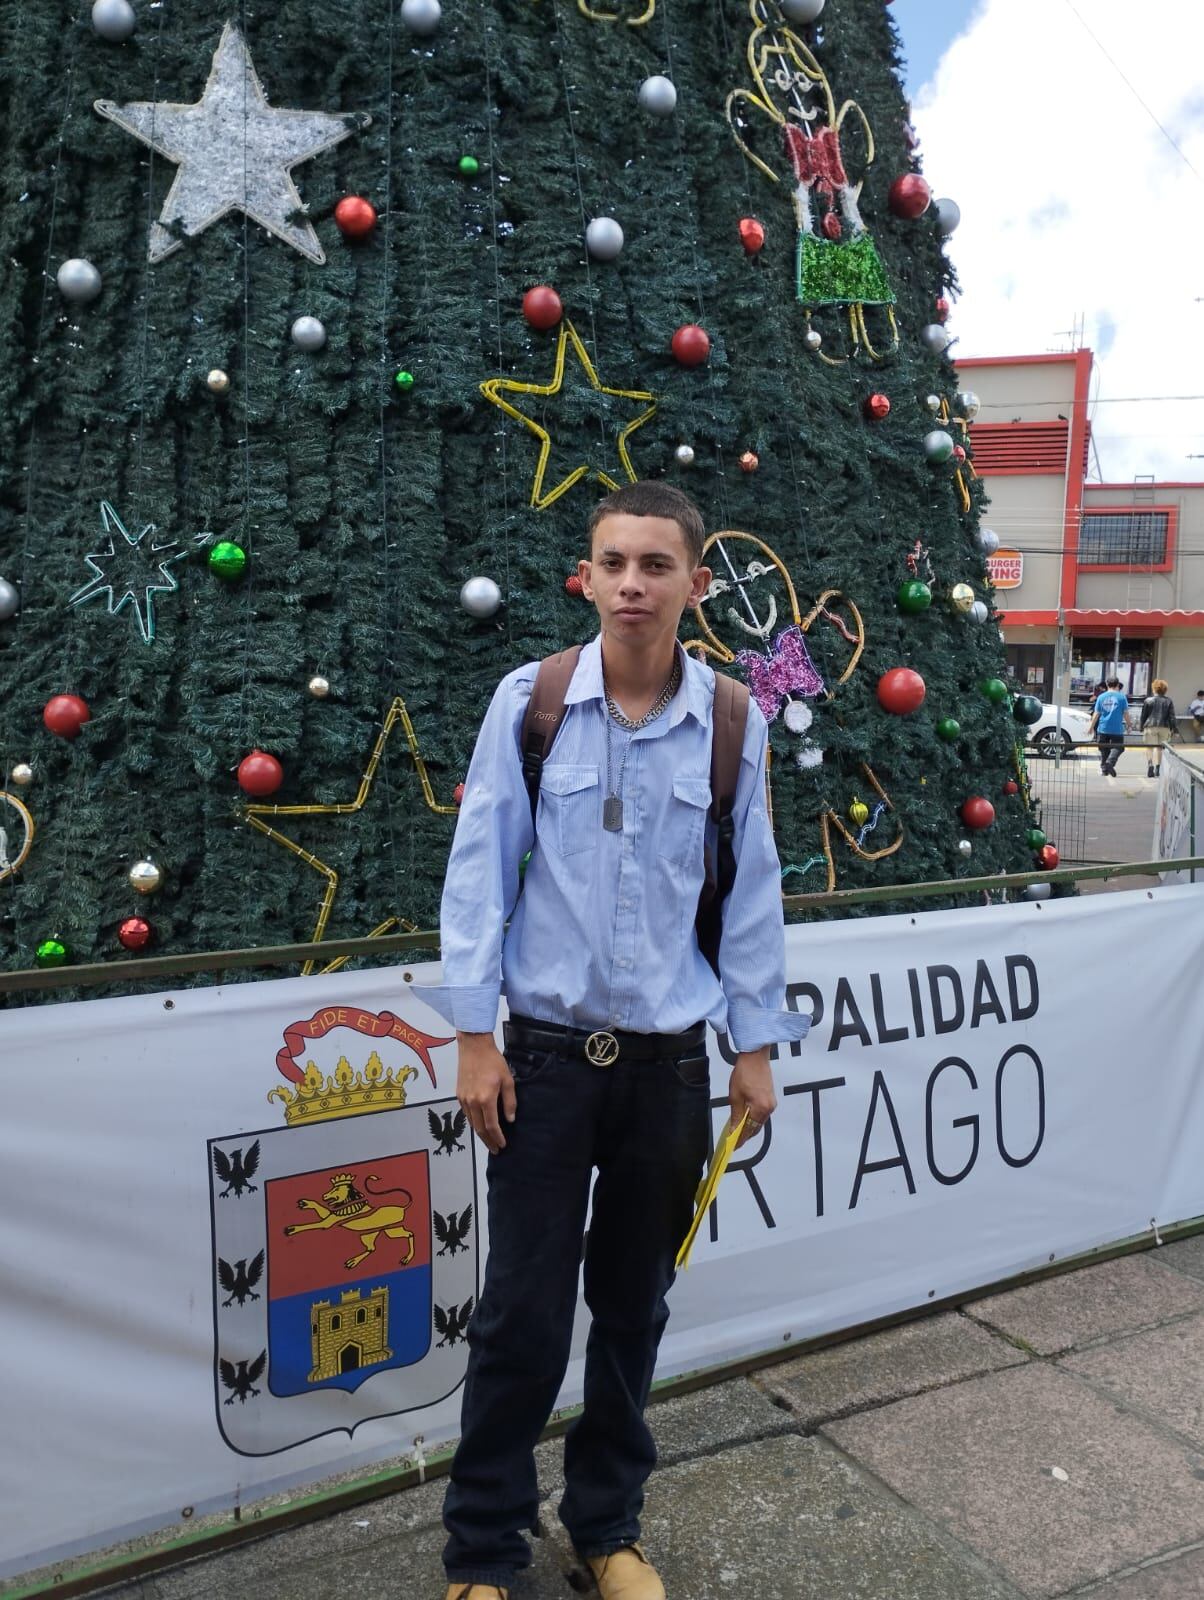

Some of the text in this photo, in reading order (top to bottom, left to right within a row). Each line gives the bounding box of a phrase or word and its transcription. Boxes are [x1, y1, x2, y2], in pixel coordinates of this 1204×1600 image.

[309, 1010, 423, 1049] FIDE ET PACE
[716, 953, 1040, 1067] PALIDAD
